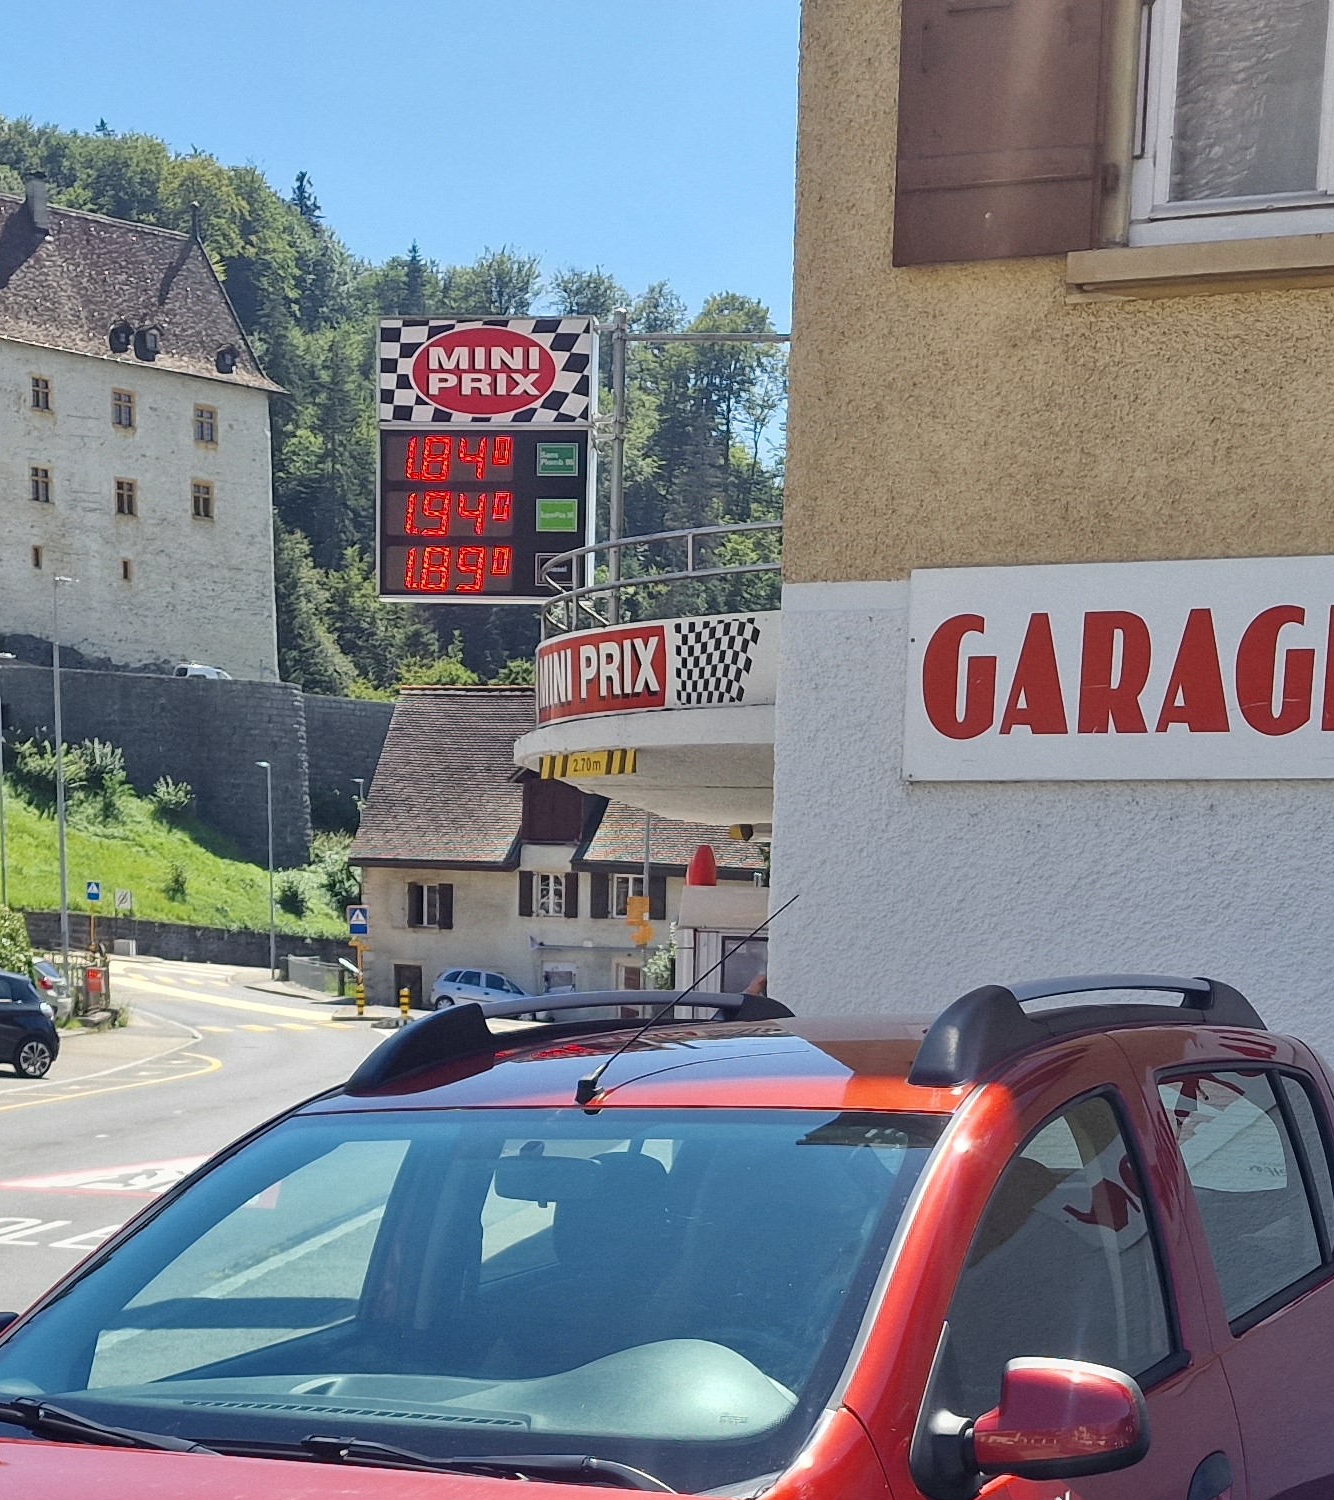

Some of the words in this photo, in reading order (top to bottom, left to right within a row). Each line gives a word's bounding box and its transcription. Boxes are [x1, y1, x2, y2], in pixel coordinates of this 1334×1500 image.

[427, 346, 540, 370] MINI
[427, 372, 541, 396] PRIX
[539, 647, 573, 709] MINI
[579, 636, 661, 699] PRIX
